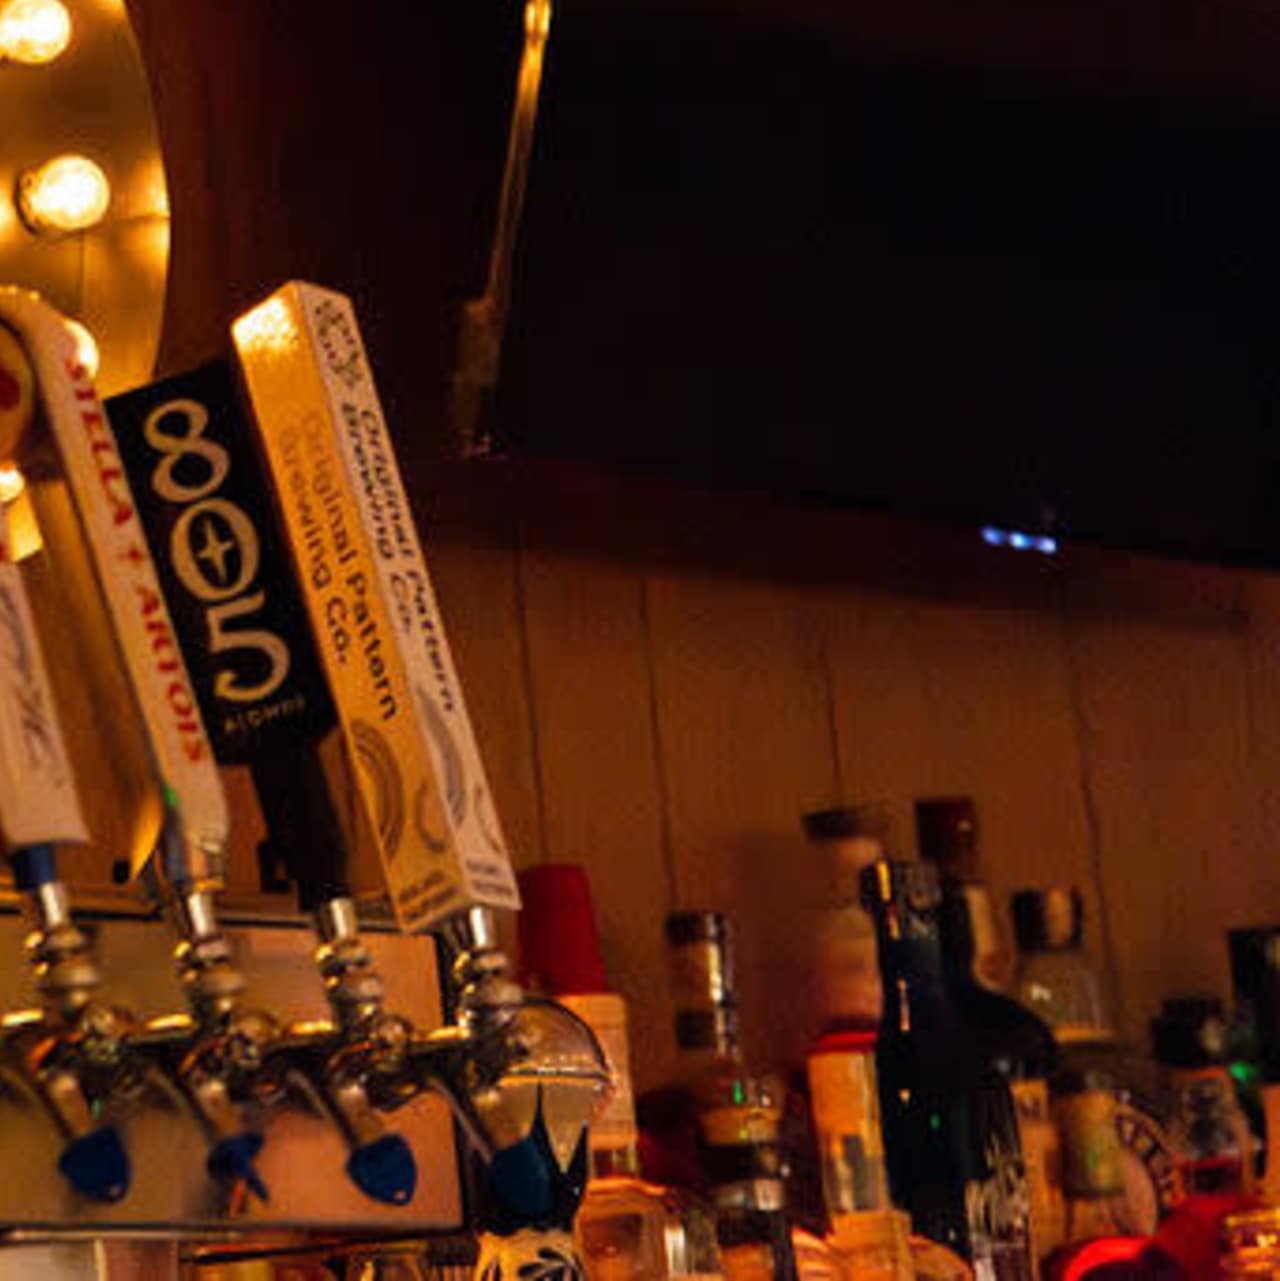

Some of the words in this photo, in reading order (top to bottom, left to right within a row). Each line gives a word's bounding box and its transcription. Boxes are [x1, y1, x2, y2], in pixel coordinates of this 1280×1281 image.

[62, 355, 136, 527] STELLA
[136, 584, 205, 764] ARTOIS
[145, 399, 290, 702] 805
[345, 571, 398, 722] Pattern
